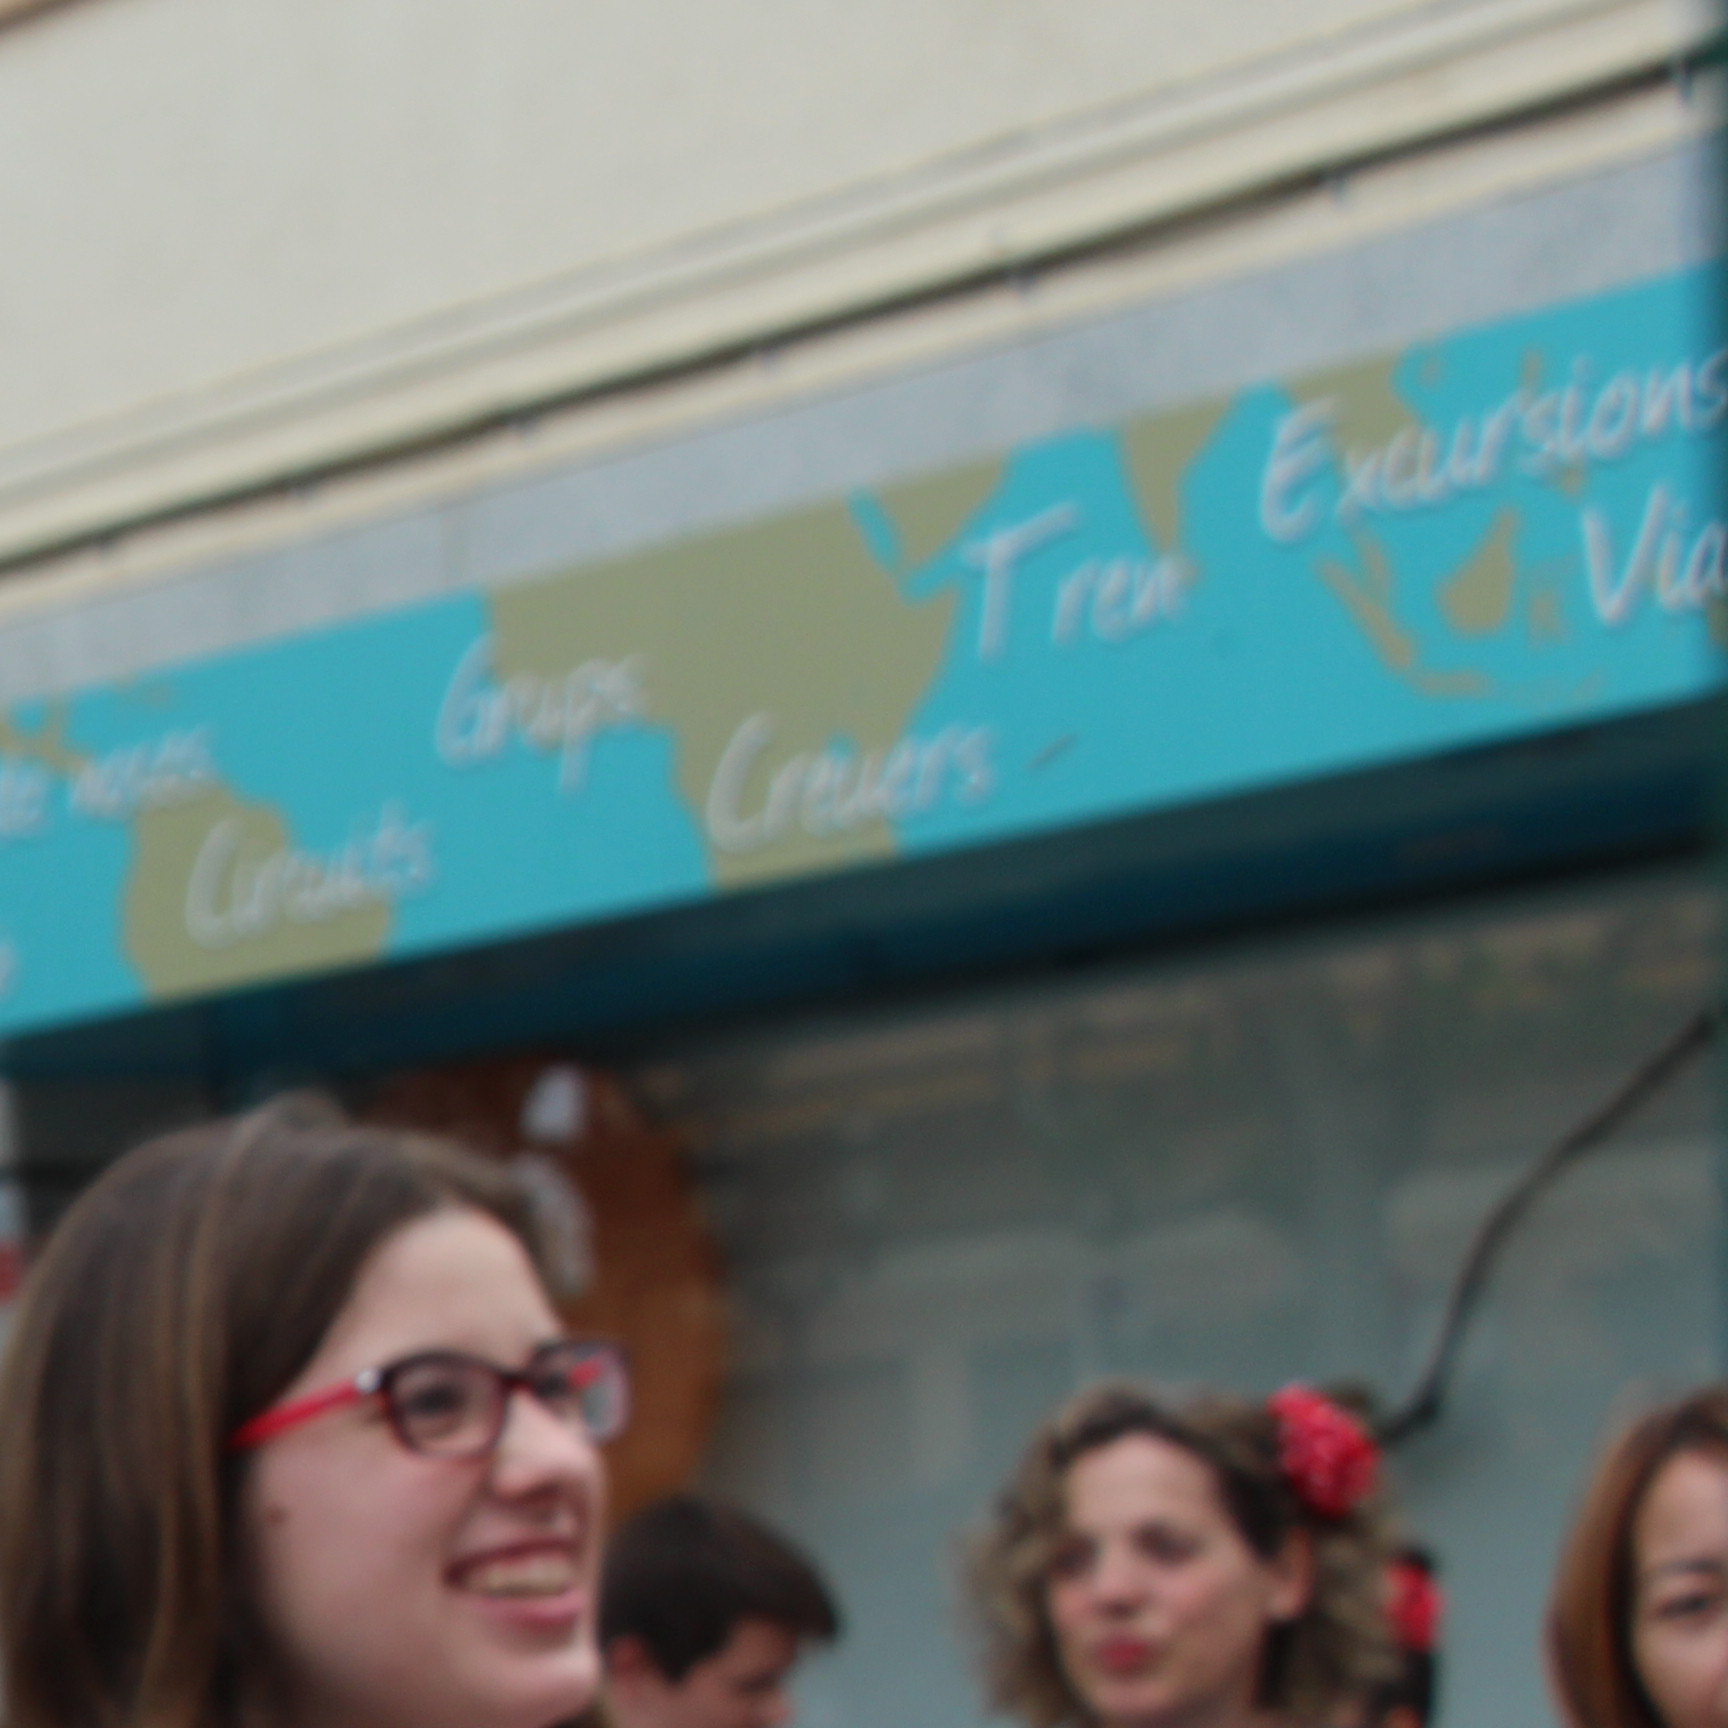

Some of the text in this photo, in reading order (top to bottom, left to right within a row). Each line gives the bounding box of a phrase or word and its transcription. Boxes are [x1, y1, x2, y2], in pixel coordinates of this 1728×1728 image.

[1259, 346, 1728, 544] Excursions
[960, 498, 1189, 664] Tren
[433, 630, 646, 794] Grups
